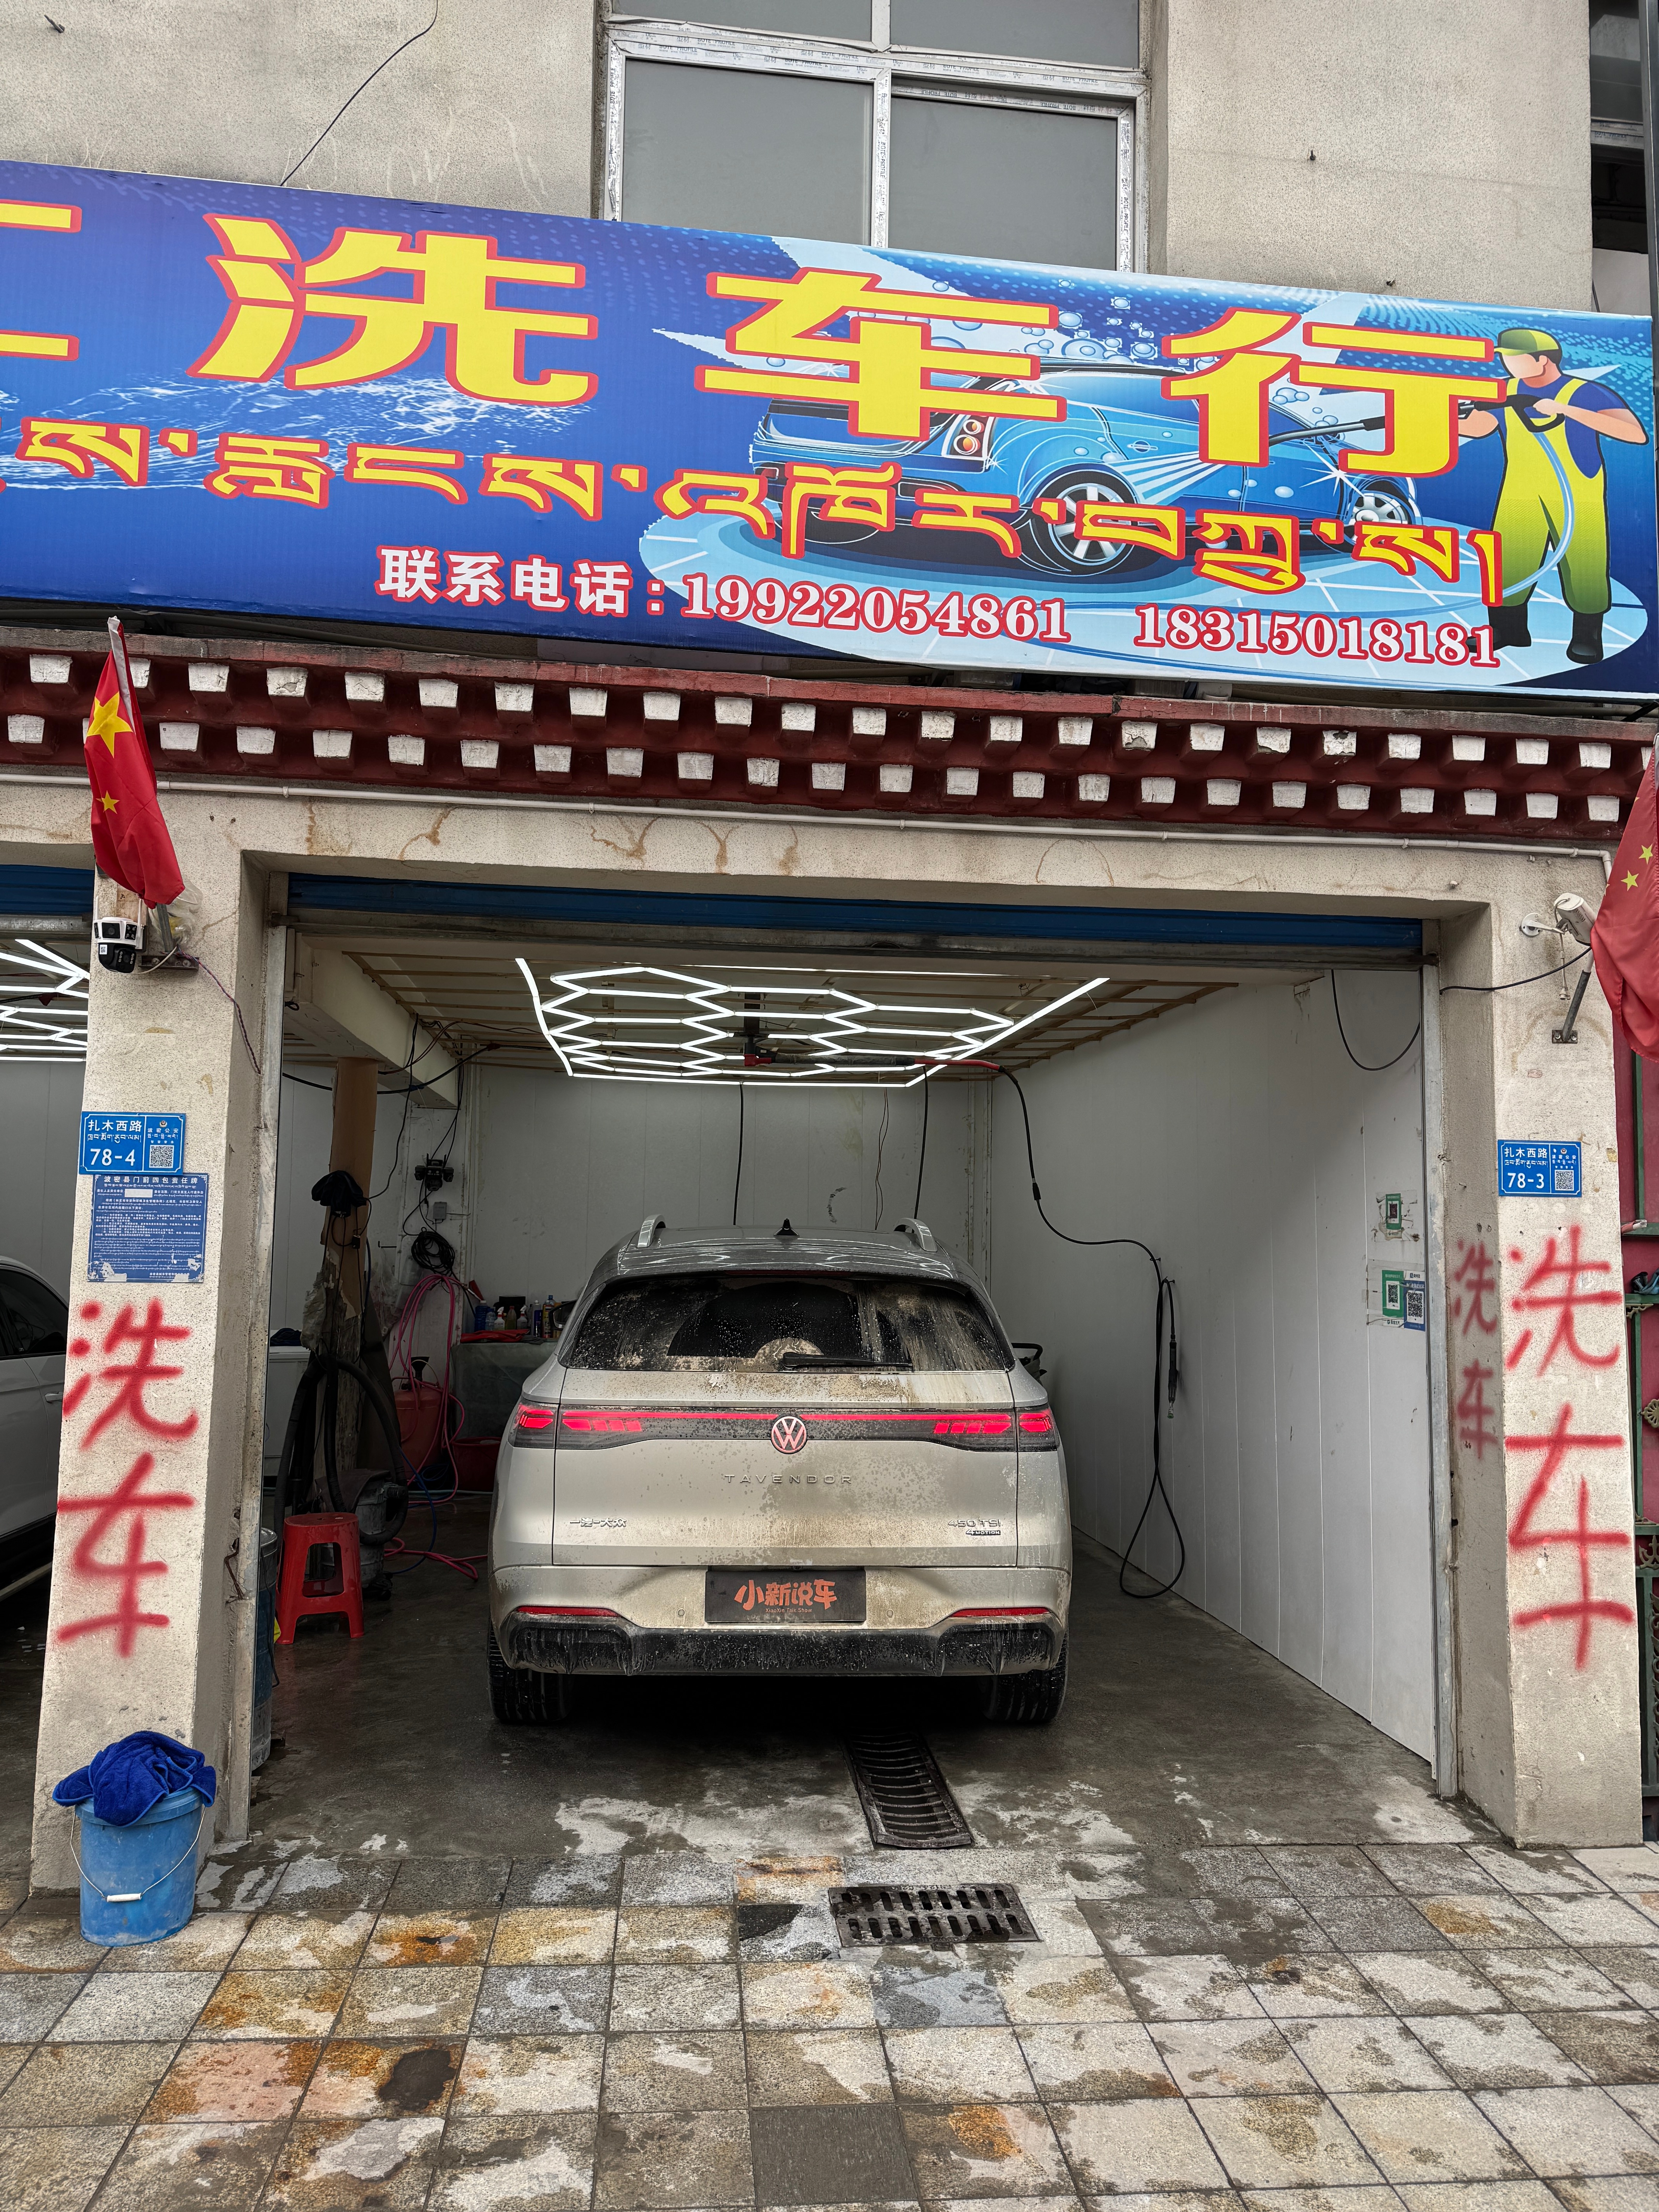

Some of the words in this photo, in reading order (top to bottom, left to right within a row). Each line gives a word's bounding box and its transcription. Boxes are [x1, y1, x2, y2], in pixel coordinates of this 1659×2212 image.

[0, 199, 1506, 478] 洗车行
[682, 572, 1071, 643] 19922054861
[1134, 603, 1500, 667] 18315018181
[88, 1119, 143, 1132] 扎木西路
[90, 1148, 136, 1166] 78-4
[1504, 1147, 1547, 1158] 扎木西路
[104, 1176, 198, 1184] 波密县门前四包责任牌
[1508, 1173, 1544, 1188] 78-3
[1454, 1239, 1498, 1459] 洗车
[1505, 1224, 1635, 1671] 洗车
[57, 1297, 198, 1658] 洗车
[725, 1474, 852, 1484] TAVENDOR
[948, 1519, 976, 1527] 450
[979, 1519, 1001, 1527] TSI
[734, 1579, 837, 1611] 小新说车
